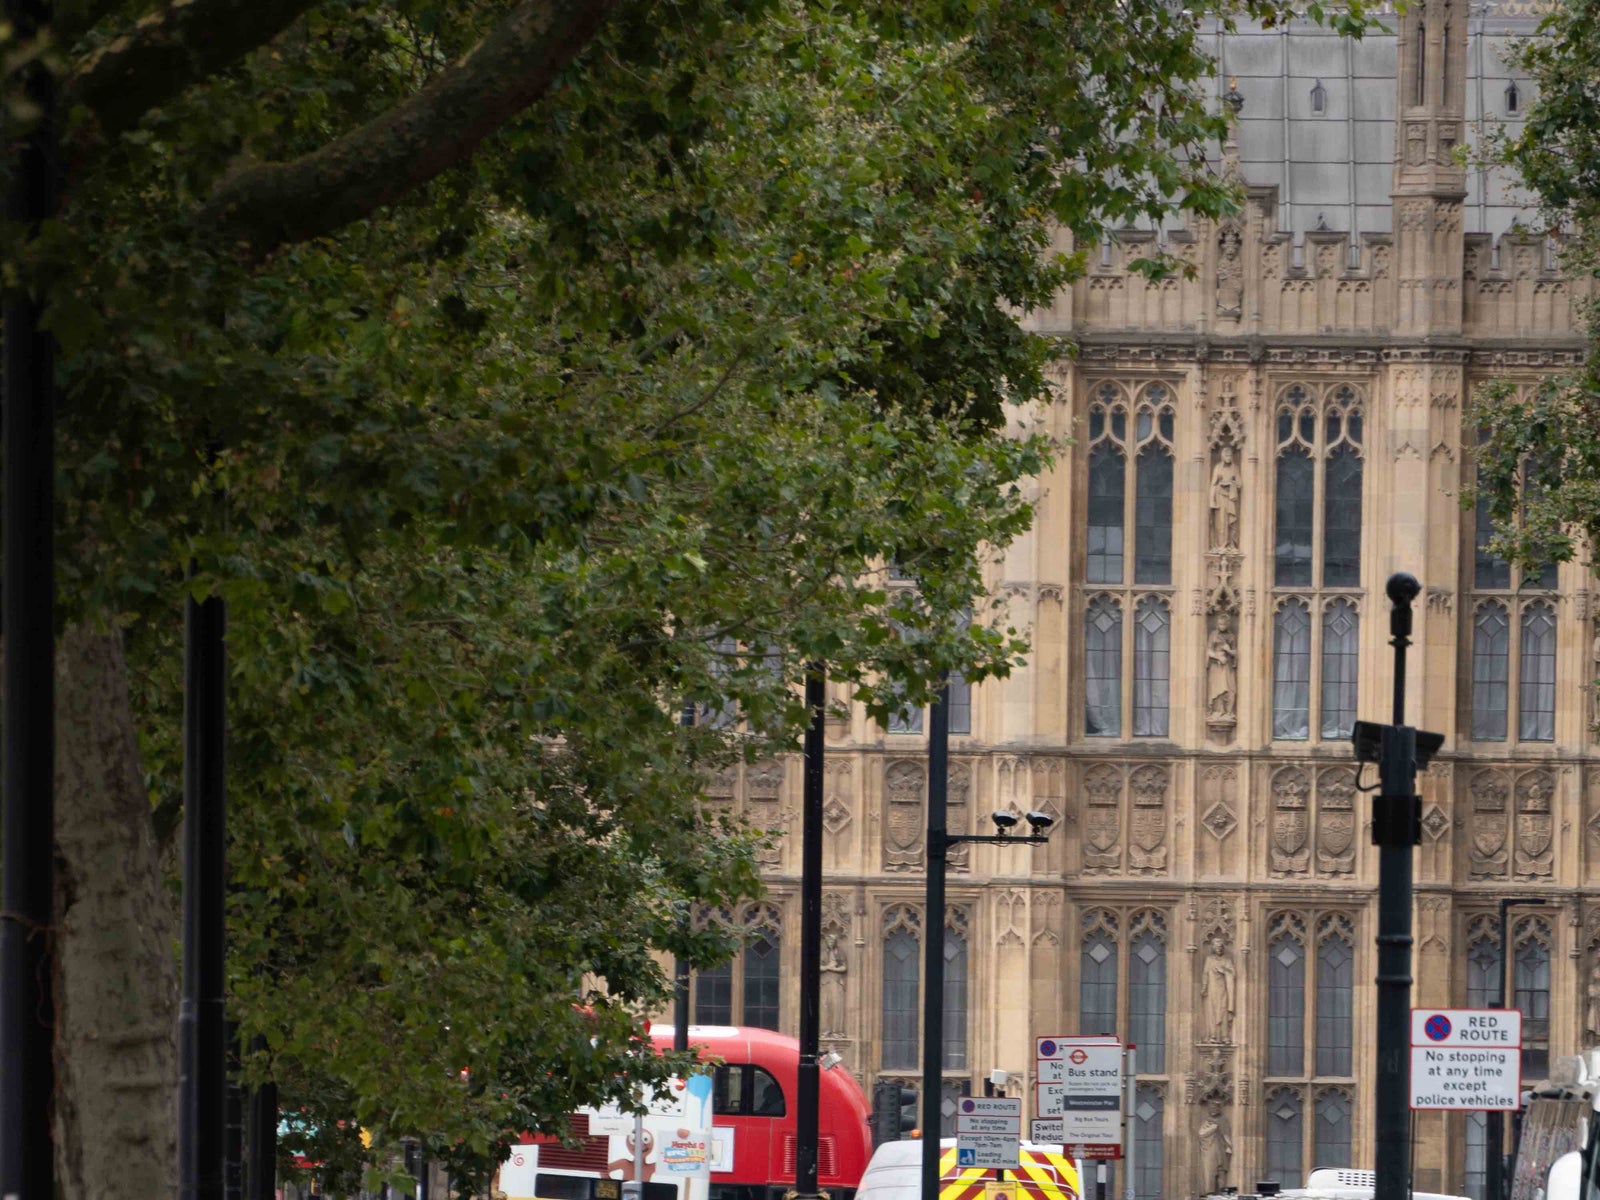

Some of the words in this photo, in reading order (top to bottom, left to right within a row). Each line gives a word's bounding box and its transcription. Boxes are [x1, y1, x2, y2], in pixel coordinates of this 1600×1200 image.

[1469, 1017, 1498, 1027] RED
[1460, 1030, 1508, 1040] ROUTE
[1426, 1050, 1444, 1061] No
[1449, 1051, 1506, 1064] stopping
[1068, 1068, 1086, 1077] Bus
[1089, 1068, 1118, 1077] stand
[1428, 1066, 1441, 1076] at
[1446, 1068, 1468, 1078] any
[1474, 1066, 1503, 1076] time
[1443, 1081, 1487, 1092] except
[1416, 1094, 1455, 1106] police
[1460, 1095, 1514, 1106] vehicles
